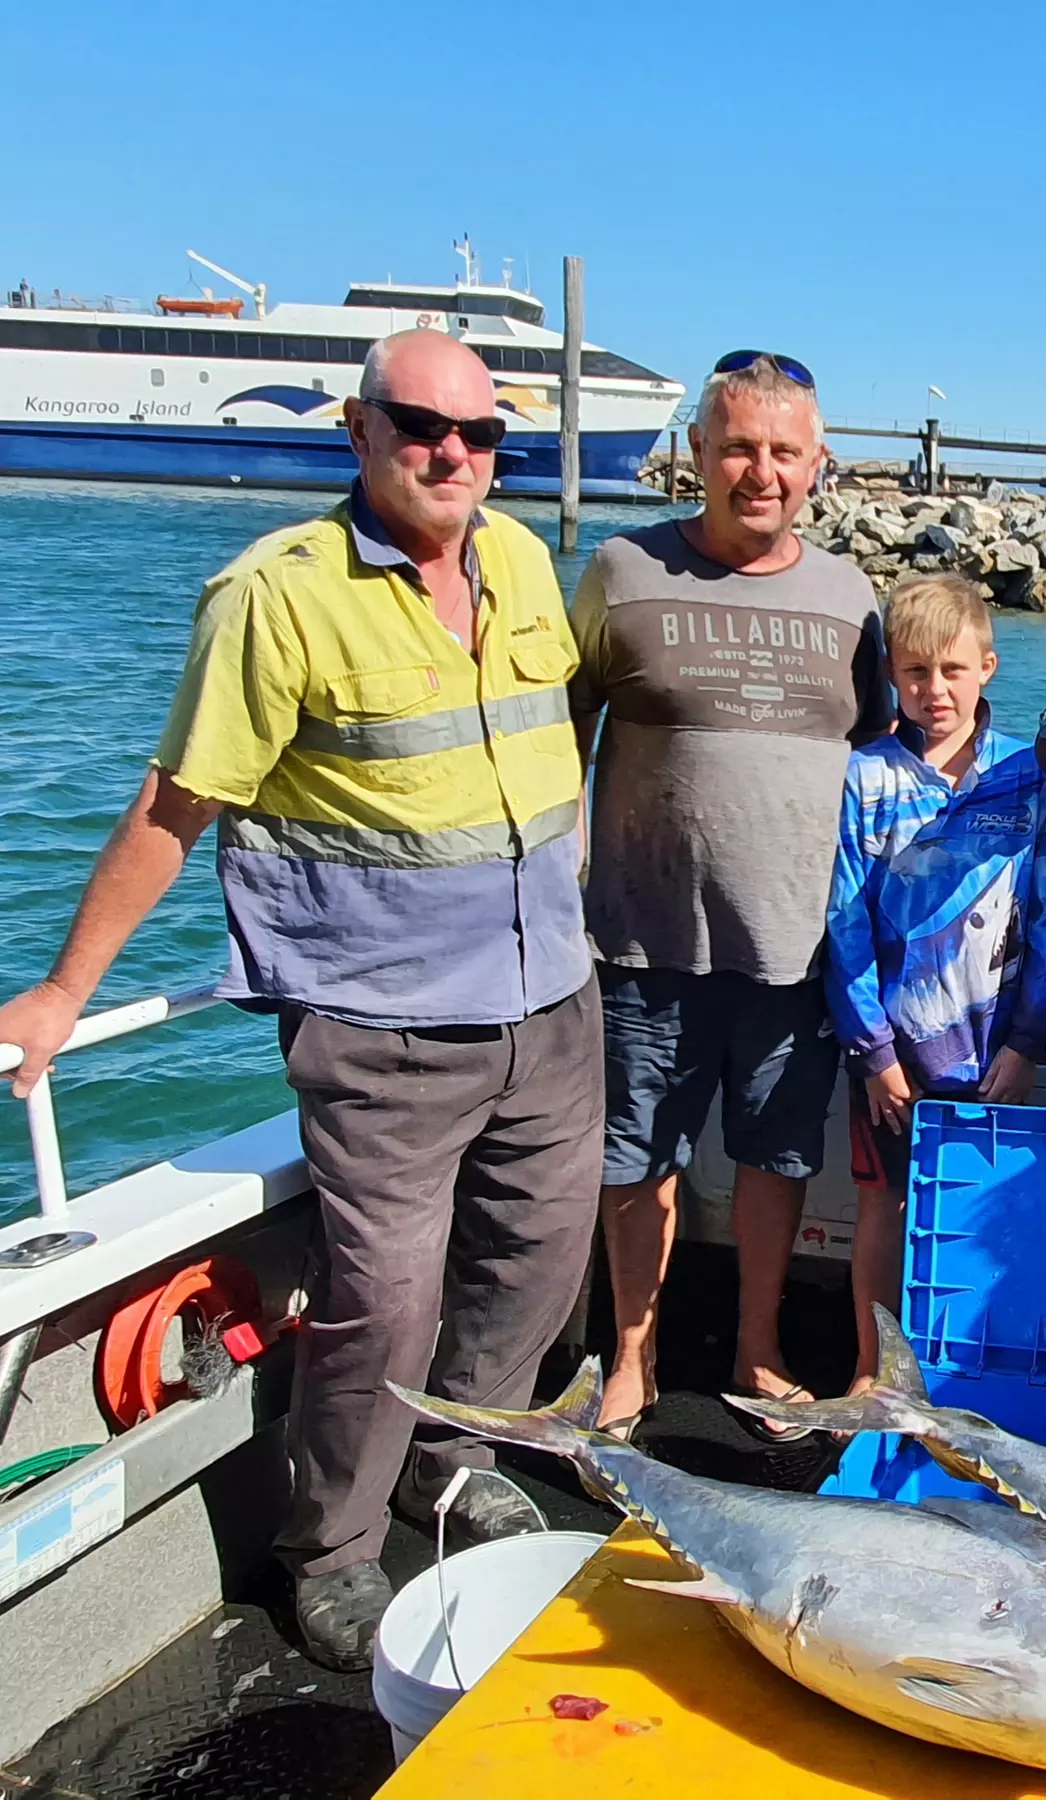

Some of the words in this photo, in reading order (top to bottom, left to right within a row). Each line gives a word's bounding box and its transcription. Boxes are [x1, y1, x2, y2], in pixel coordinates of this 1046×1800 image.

[25, 396, 120, 416] Kangaroo
[135, 400, 192, 416] Island
[661, 612, 840, 661] BILLABONG
[679, 666, 740, 679] PREMIUM
[785, 673, 834, 688] QUALITY
[714, 700, 747, 716] MADE
